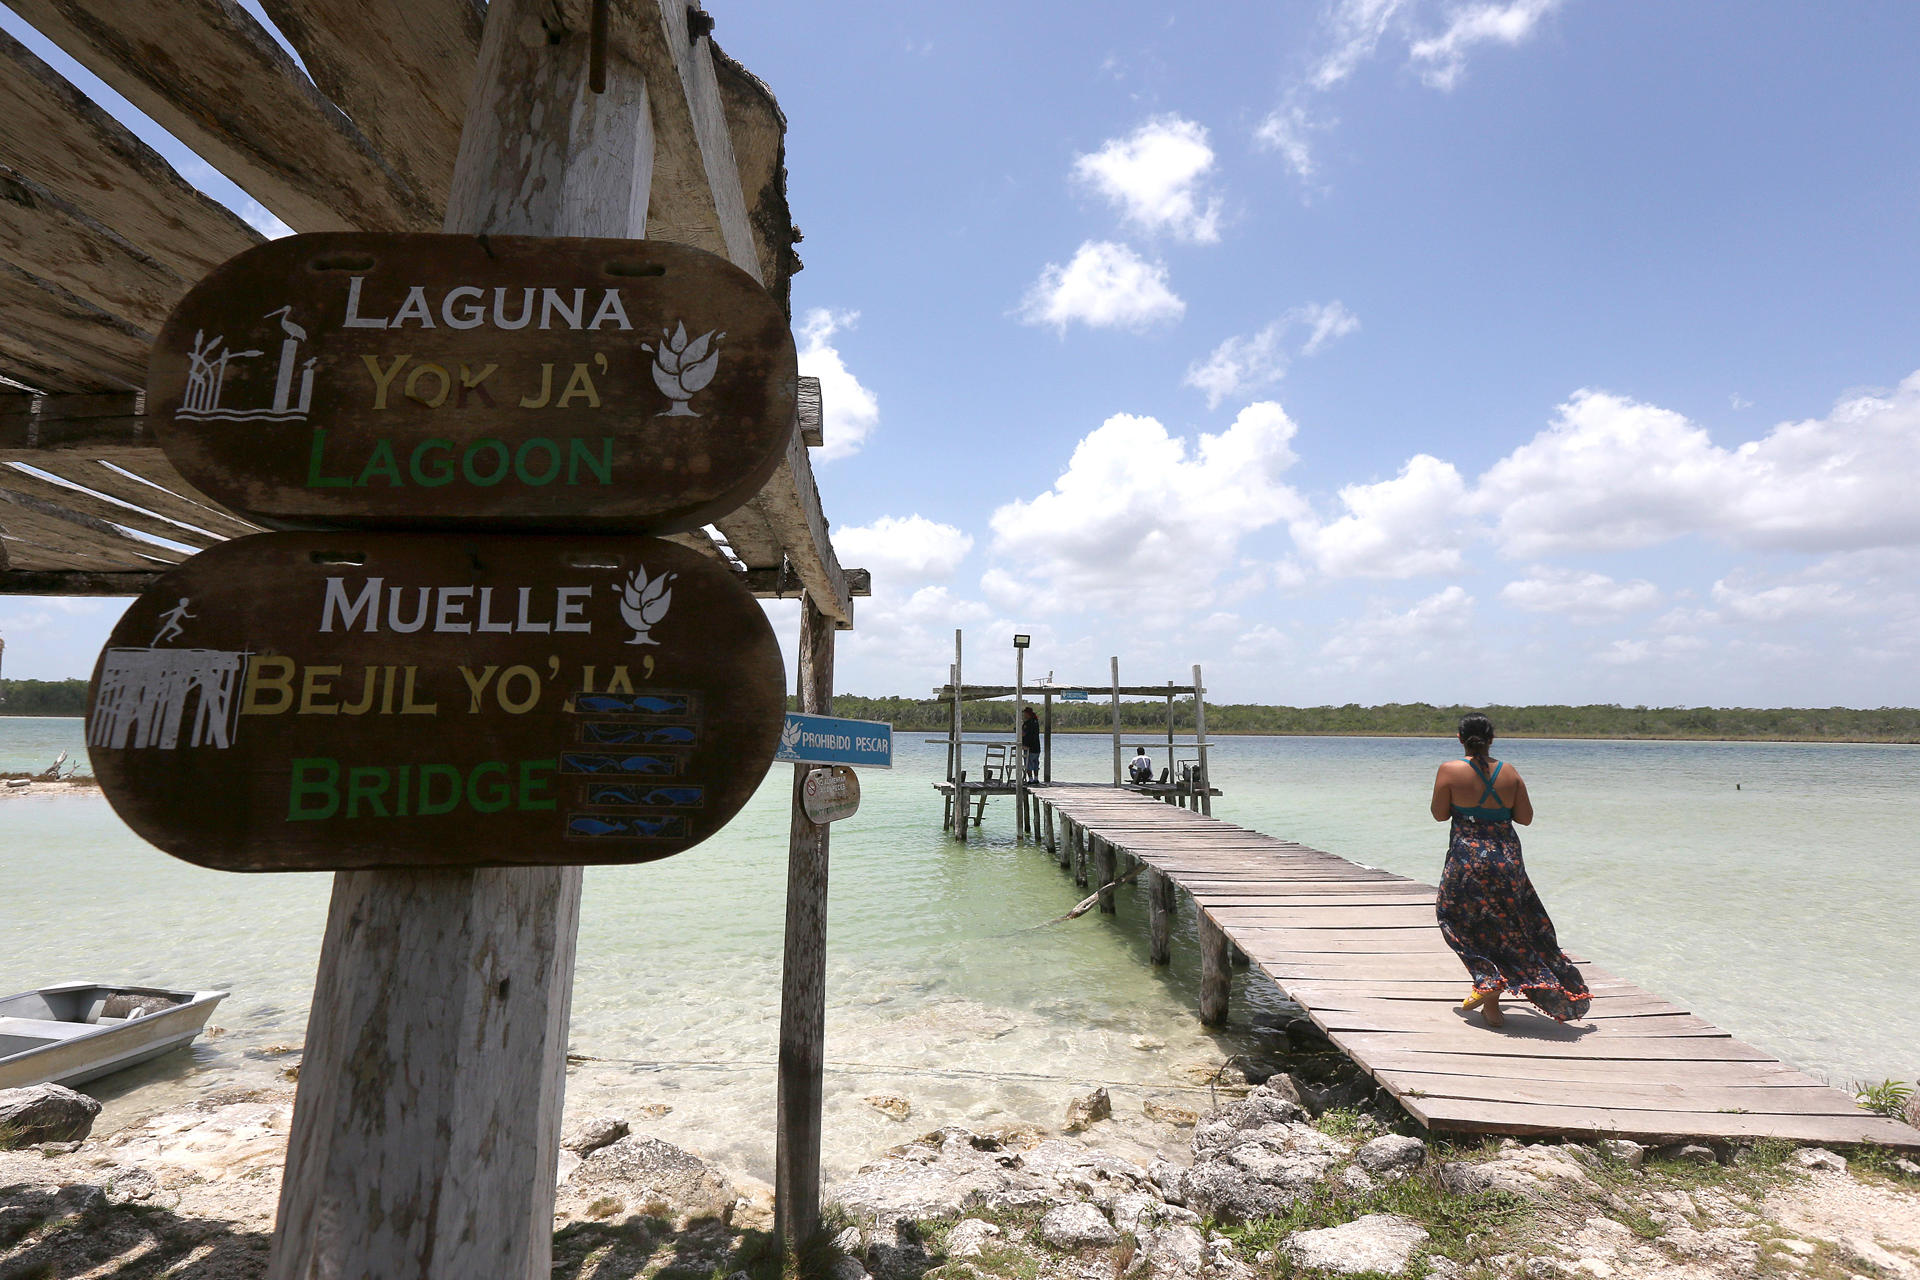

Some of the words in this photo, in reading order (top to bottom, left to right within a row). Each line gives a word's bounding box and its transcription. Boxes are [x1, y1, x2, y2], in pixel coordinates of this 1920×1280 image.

[342, 275, 634, 332] LAGUNA
[518, 352, 609, 409] JA'
[307, 430, 615, 489] LAGOON
[319, 577, 593, 635] MUELLE
[240, 655, 438, 716] BEJIL
[802, 732, 851, 751] PROHIBIDO
[855, 737, 889, 755] PESCAR
[286, 758, 558, 822] BRIDGE
